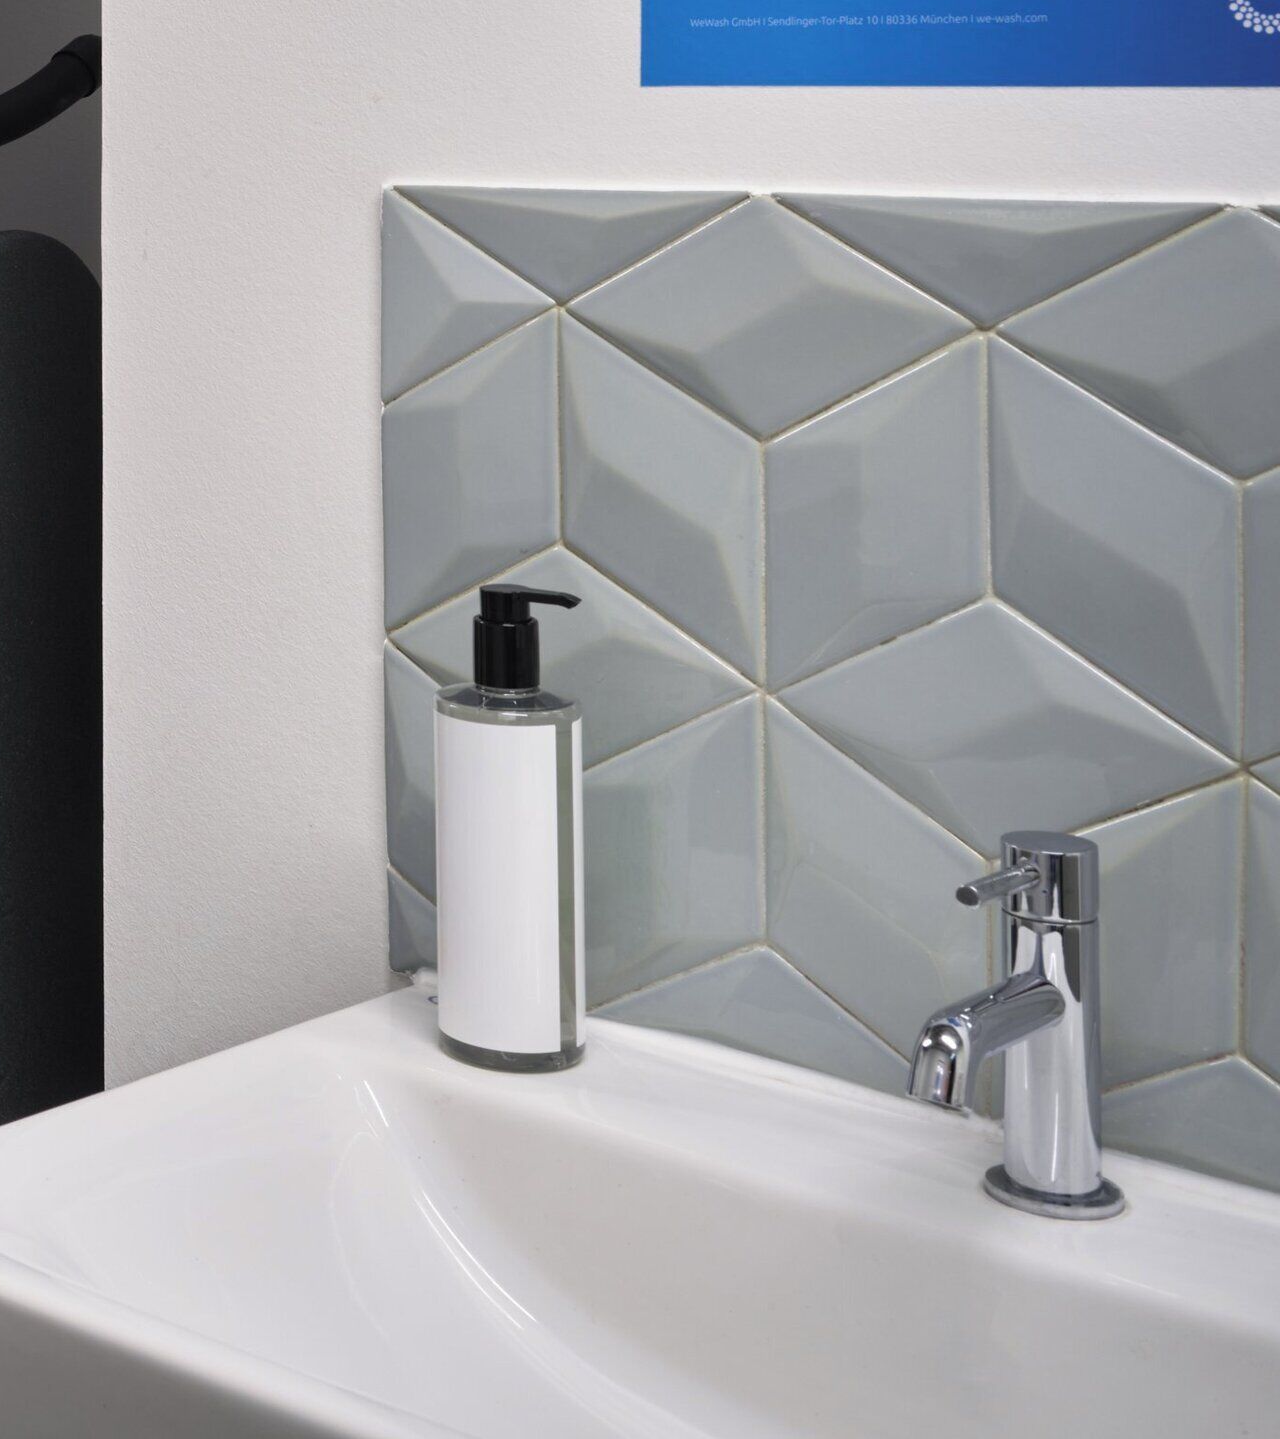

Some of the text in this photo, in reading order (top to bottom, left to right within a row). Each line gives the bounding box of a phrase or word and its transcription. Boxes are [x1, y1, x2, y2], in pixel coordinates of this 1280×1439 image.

[690, 13, 1049, 29] WeWash GmbH Sendlinger-Tor-Platz 10 80336 München we-wash.com
